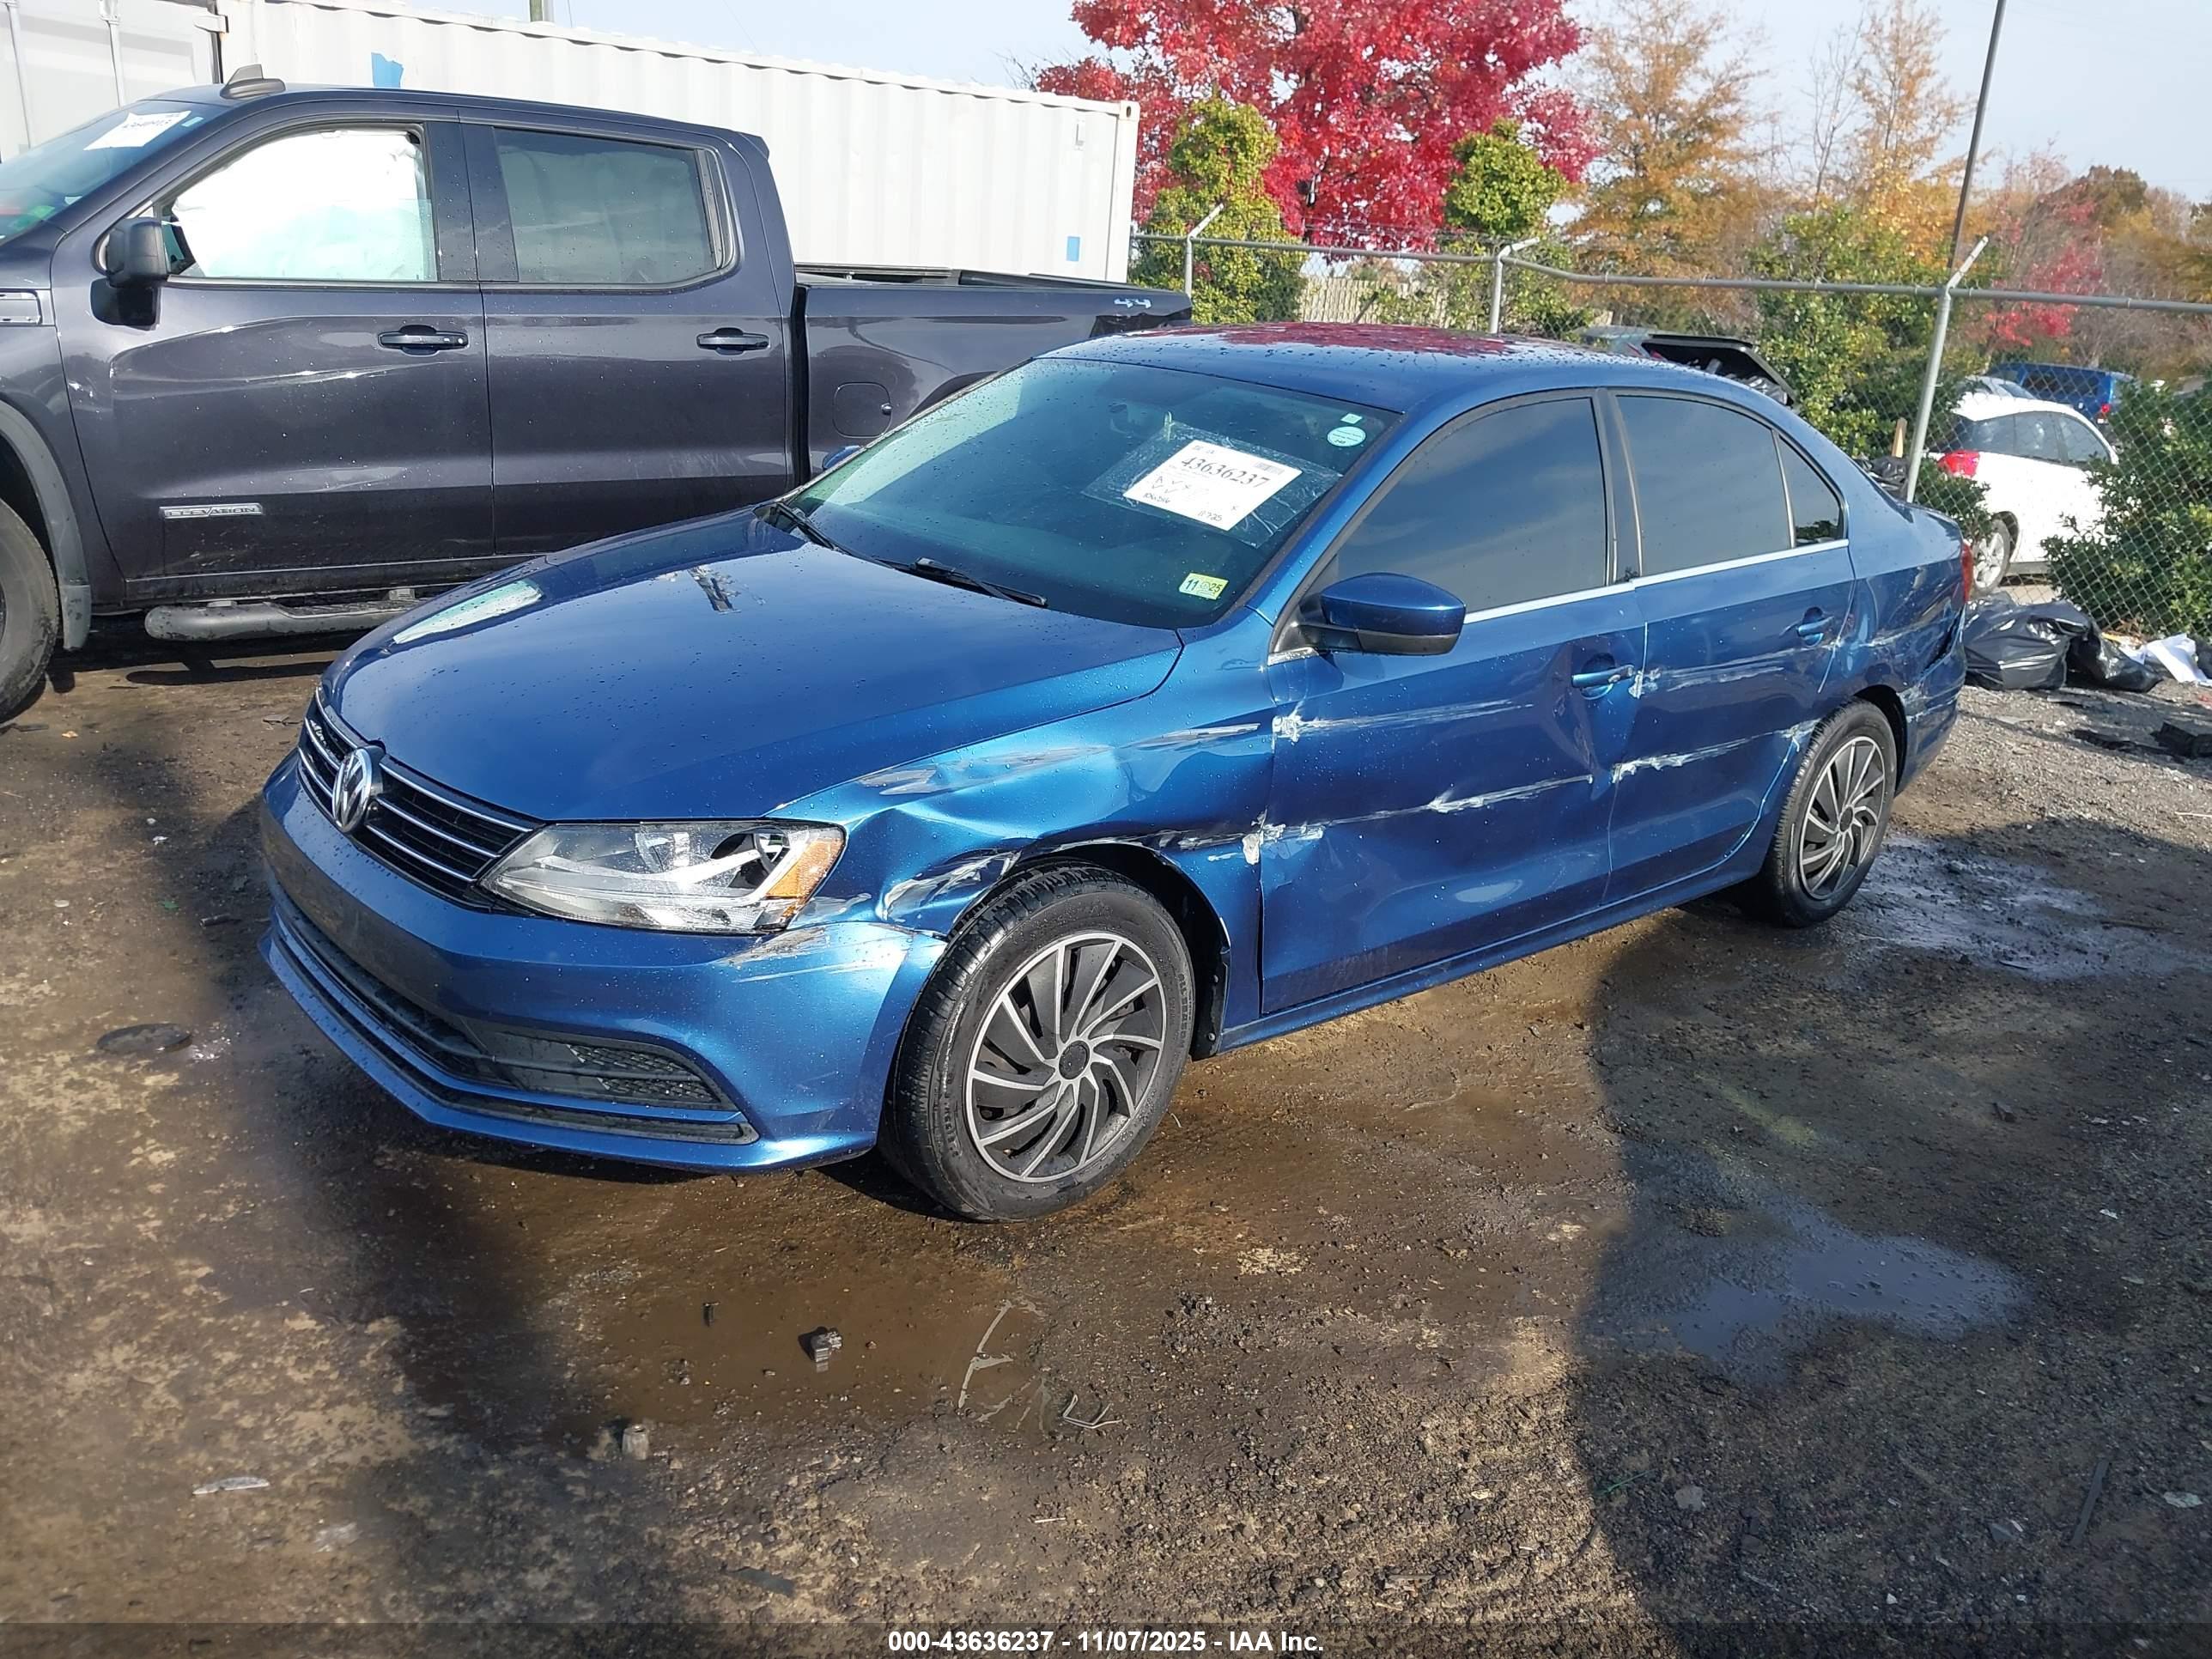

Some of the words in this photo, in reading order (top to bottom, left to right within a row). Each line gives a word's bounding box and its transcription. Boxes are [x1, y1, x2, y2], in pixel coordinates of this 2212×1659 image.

[1181, 456, 1272, 489] 43636237
[168, 506, 257, 517] ELEVATION
[1186, 579, 1200, 591] 11
[1208, 582, 1224, 592] 25
